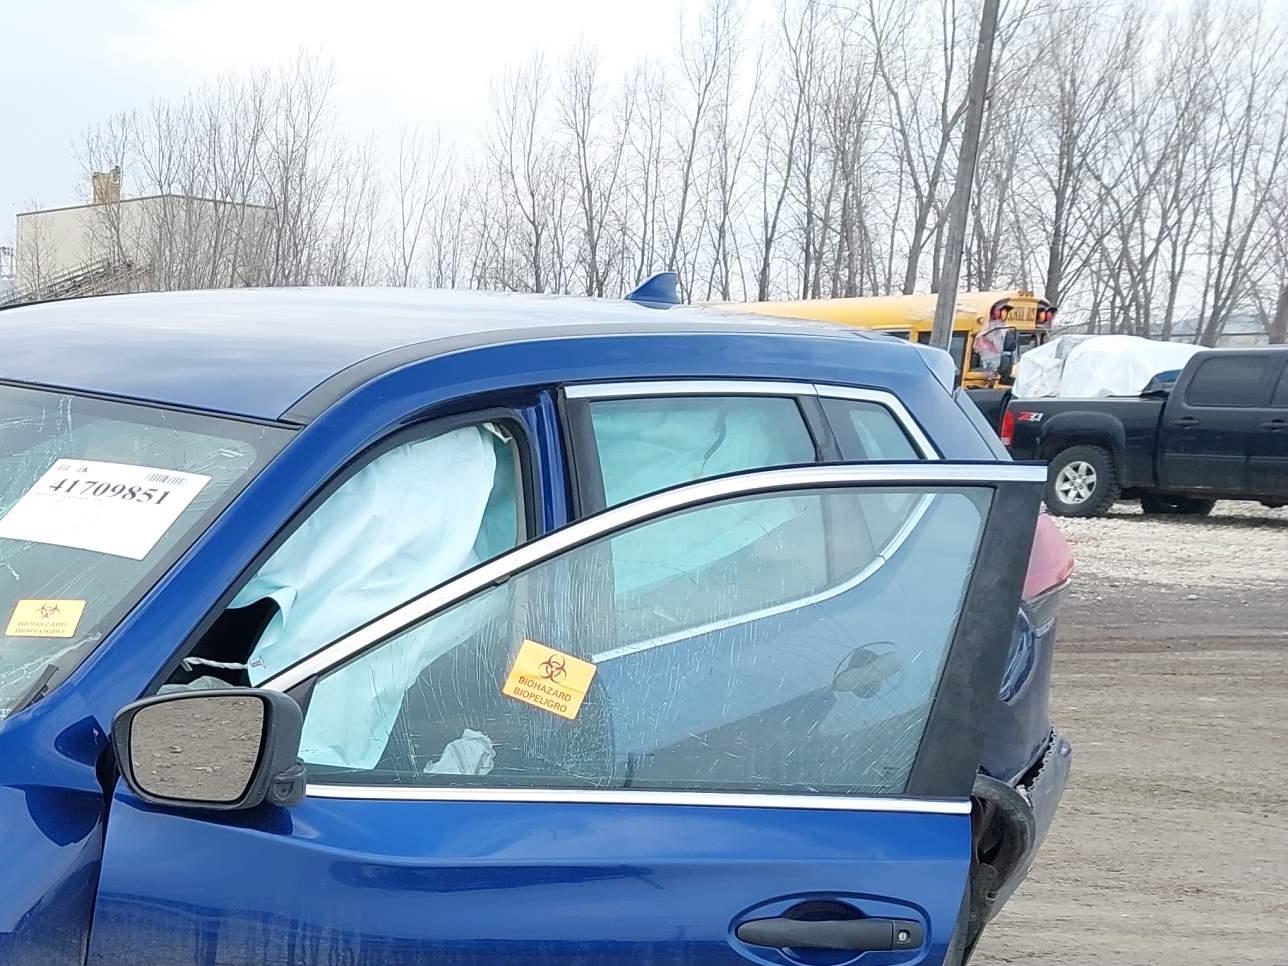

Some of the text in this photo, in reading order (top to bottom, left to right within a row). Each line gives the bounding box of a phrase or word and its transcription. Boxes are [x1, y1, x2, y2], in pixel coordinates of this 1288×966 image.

[49, 478, 171, 505] 41709851
[513, 686, 568, 713] BIOPELIGRO
[518, 676, 572, 702] BIOHAZARD
